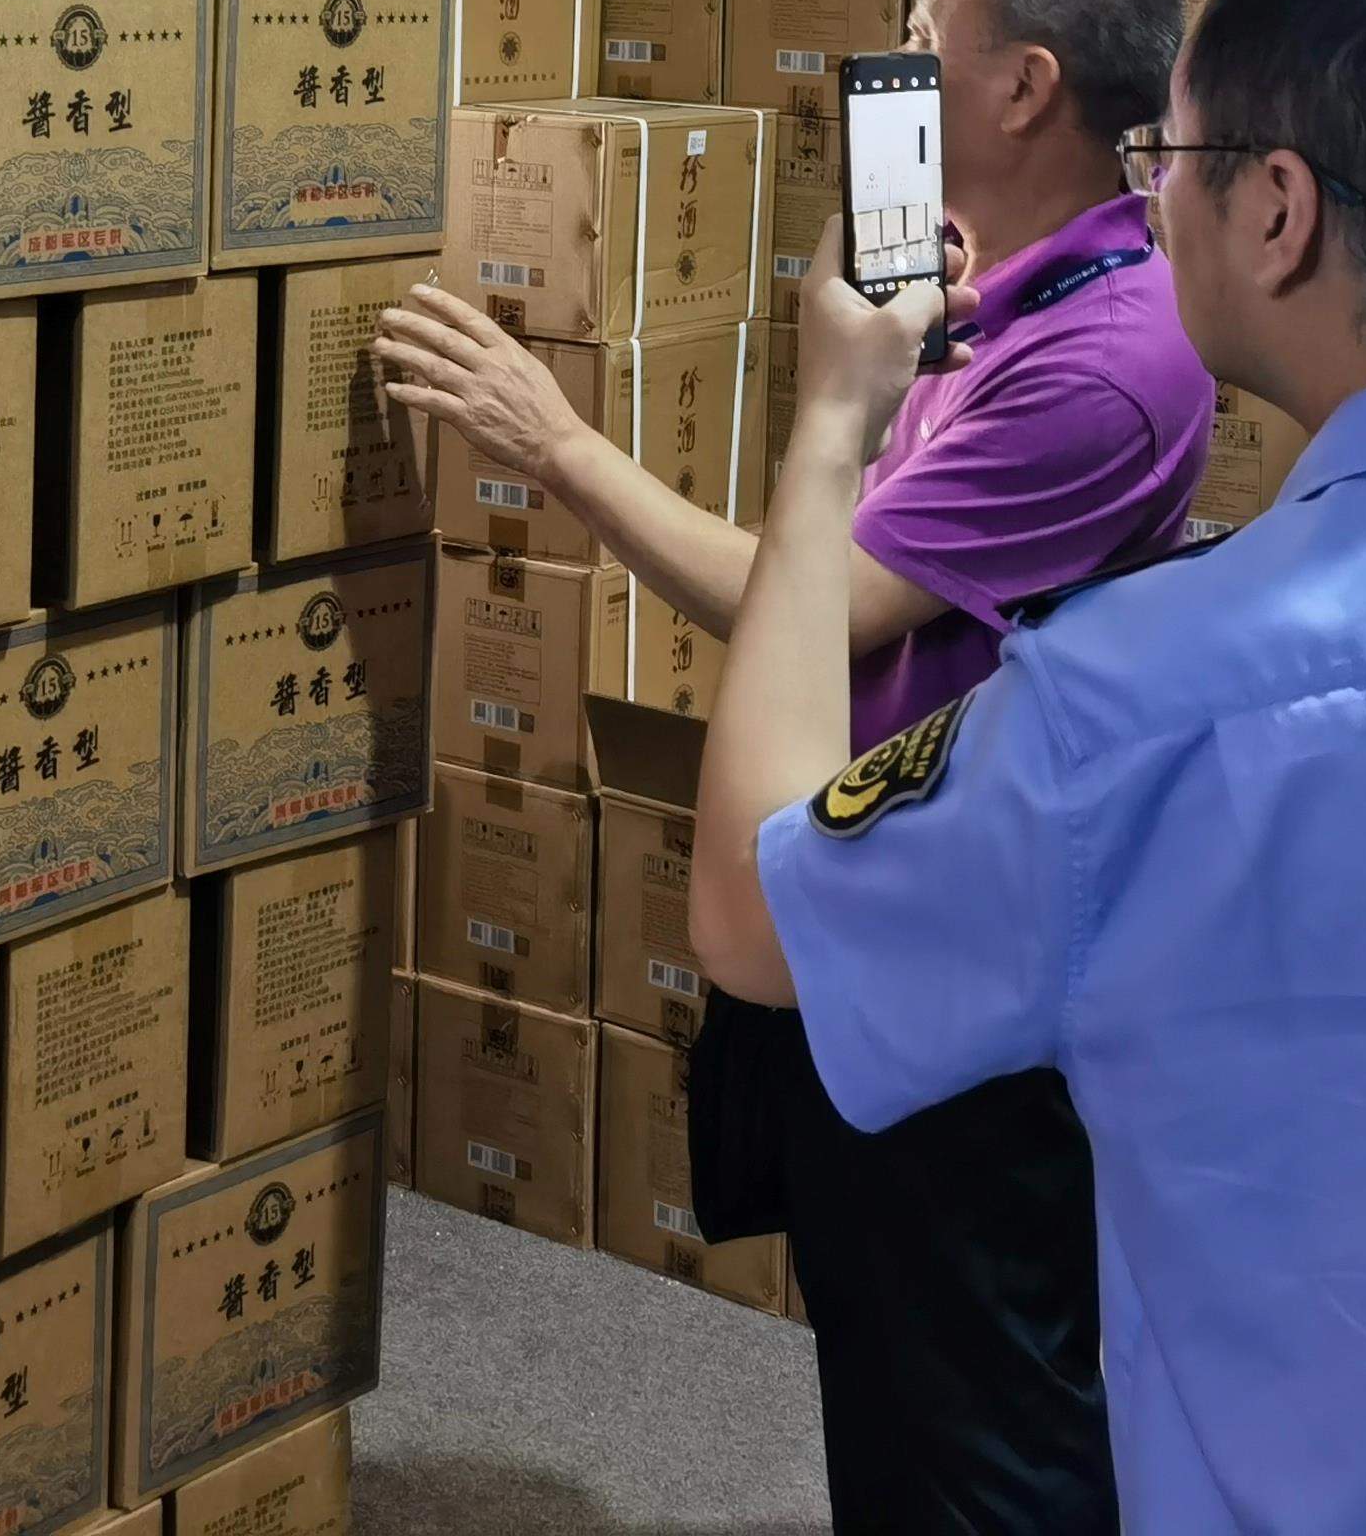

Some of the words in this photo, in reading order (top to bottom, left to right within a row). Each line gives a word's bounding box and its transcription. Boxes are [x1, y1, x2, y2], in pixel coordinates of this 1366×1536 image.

[336, 9, 350, 26] 15
[71, 28, 88, 46] 15
[293, 64, 386, 111] 醬香型
[21, 86, 133, 139] 醬香型
[27, 228, 122, 253] 成都军区专供
[677, 366, 703, 454] 珍酒
[314, 611, 329, 629] 15
[40, 675, 57, 696] 15
[270, 656, 368, 719] 醬香型
[263, 1202, 278, 1224] 15
[217, 1239, 316, 1327] 醬香型
